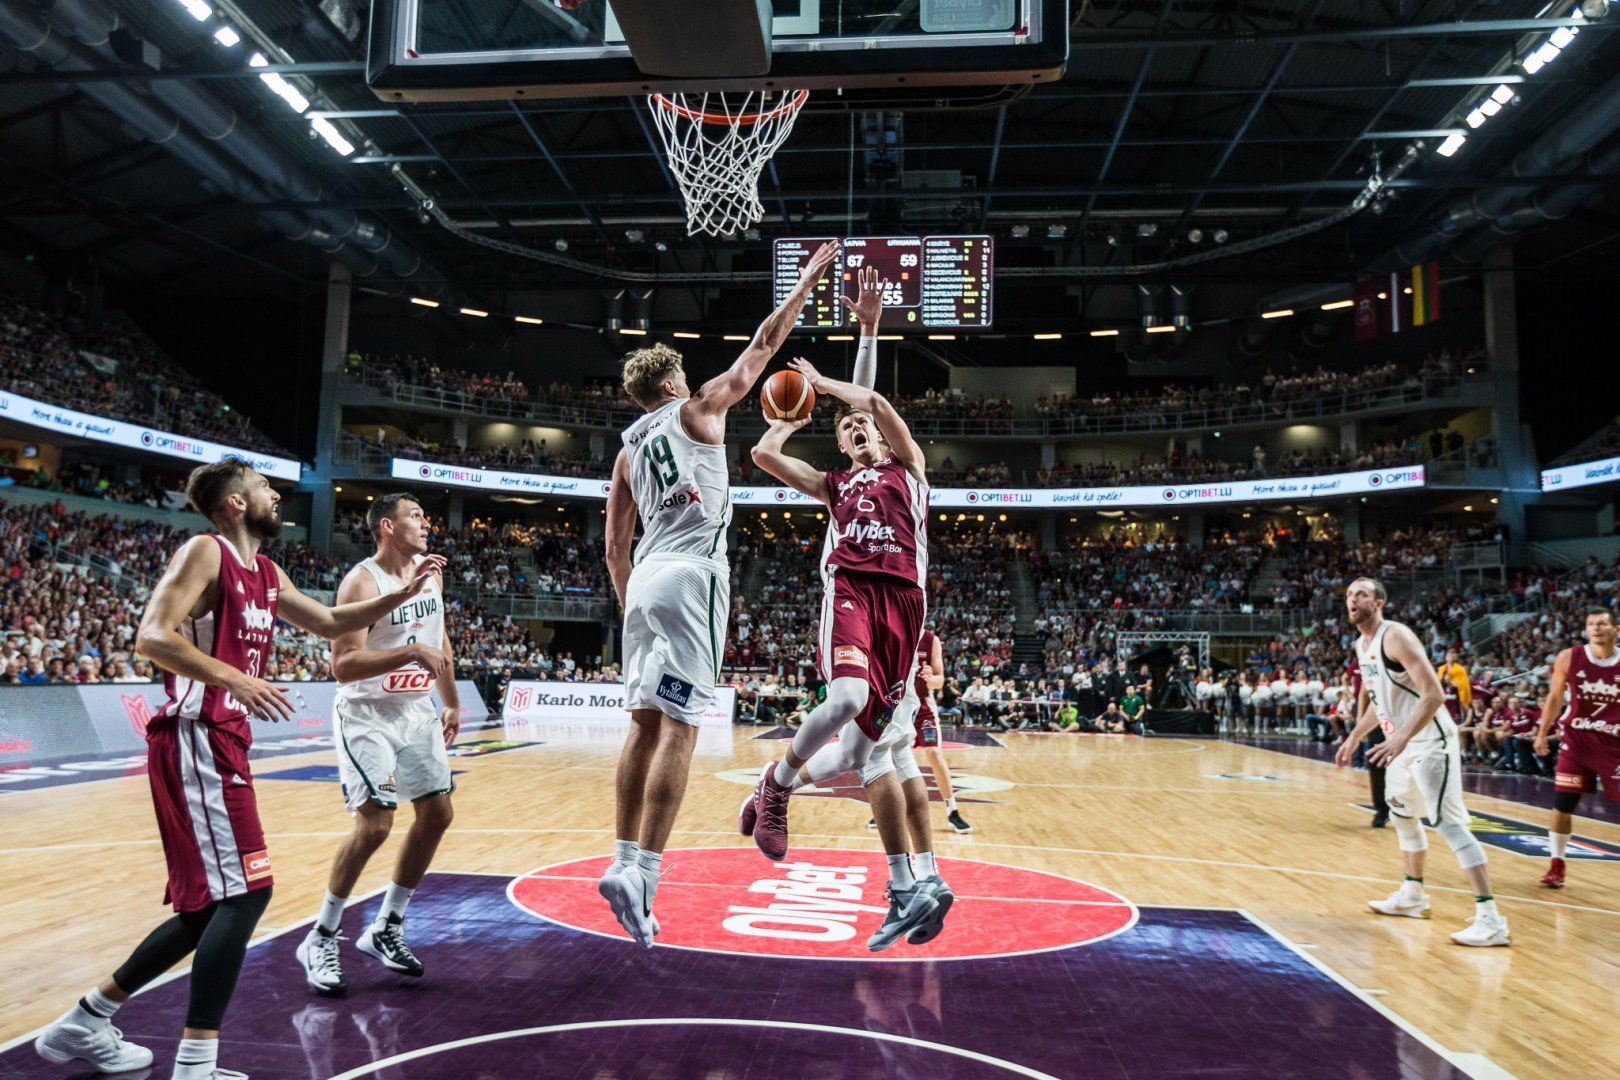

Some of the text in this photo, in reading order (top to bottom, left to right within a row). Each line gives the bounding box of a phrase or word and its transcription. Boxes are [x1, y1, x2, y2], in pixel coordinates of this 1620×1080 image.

[847, 255, 864, 267] 67
[900, 254, 918, 266] 59
[643, 434, 680, 494] 19
[500, 476, 520, 485] More
[857, 494, 876, 512] 6
[390, 598, 437, 625] LIETUVA
[246, 648, 261, 678] 31
[536, 694, 624, 708] Karlo Mot
[660, 684, 688, 704] Vytautas
[1590, 702, 1608, 717] 7
[722, 862, 891, 942] OlyBet
